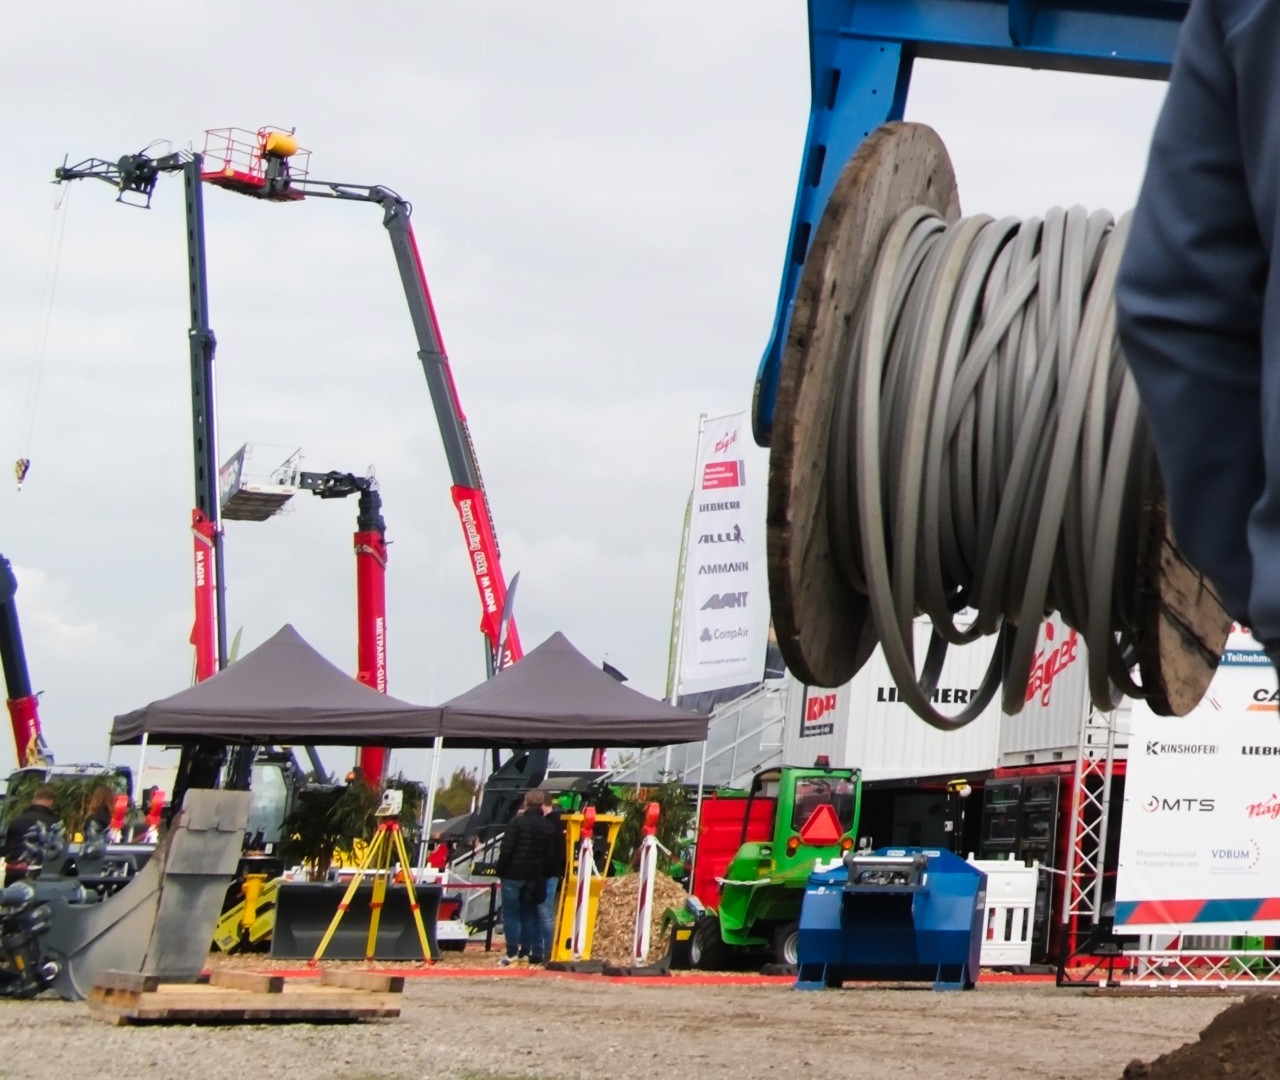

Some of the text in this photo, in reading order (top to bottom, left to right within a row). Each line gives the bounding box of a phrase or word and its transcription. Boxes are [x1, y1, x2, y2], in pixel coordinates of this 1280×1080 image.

[699, 501, 741, 512] LIEBHERR
[195, 551, 205, 587] MAGNI
[698, 562, 749, 575] AMMANN
[481, 577, 496, 613] MAGNI
[713, 627, 749, 641] CompAir
[375, 617, 385, 694] MIETPARK-GUS
[1160, 744, 1216, 754] KINSHOFER
[1162, 799, 1215, 812] MTS
[1211, 849, 1250, 859] VDBUM
